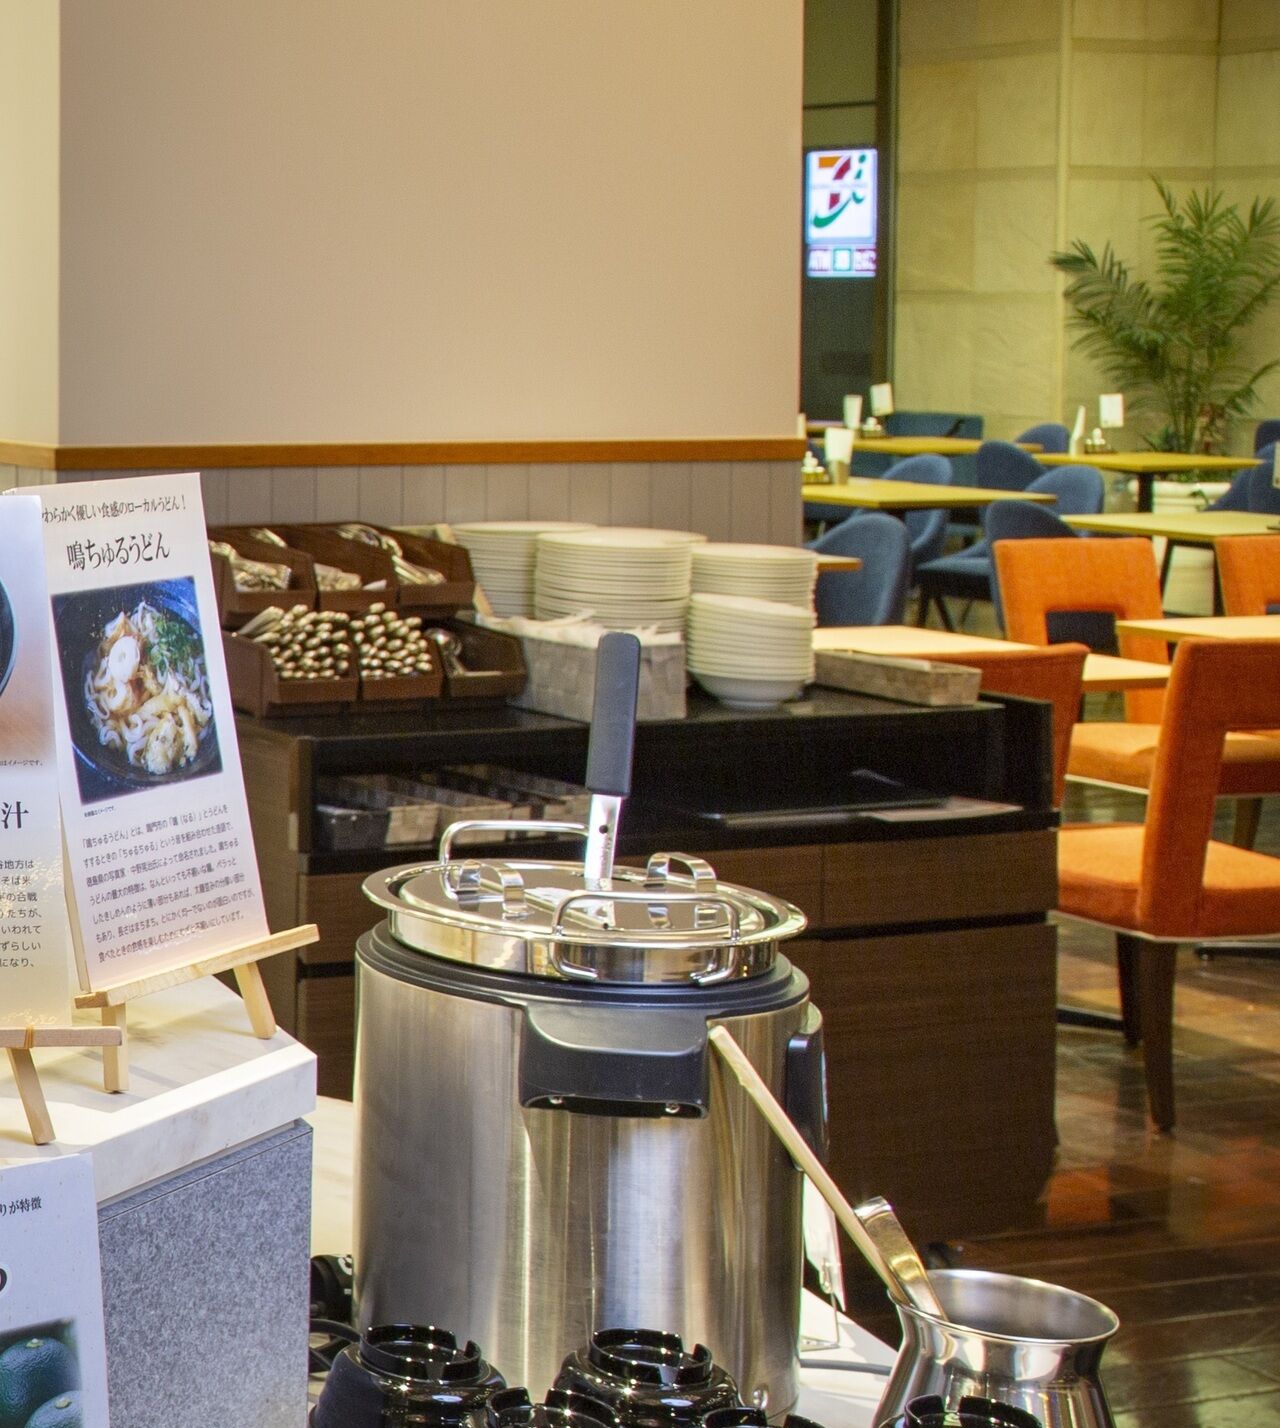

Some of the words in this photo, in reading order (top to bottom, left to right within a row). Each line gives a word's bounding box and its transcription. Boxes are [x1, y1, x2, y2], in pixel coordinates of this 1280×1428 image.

[42, 494, 186, 524] わらかく優しい食感のローカルうどん！
[66, 531, 170, 571] 鳴ちゅるうどん
